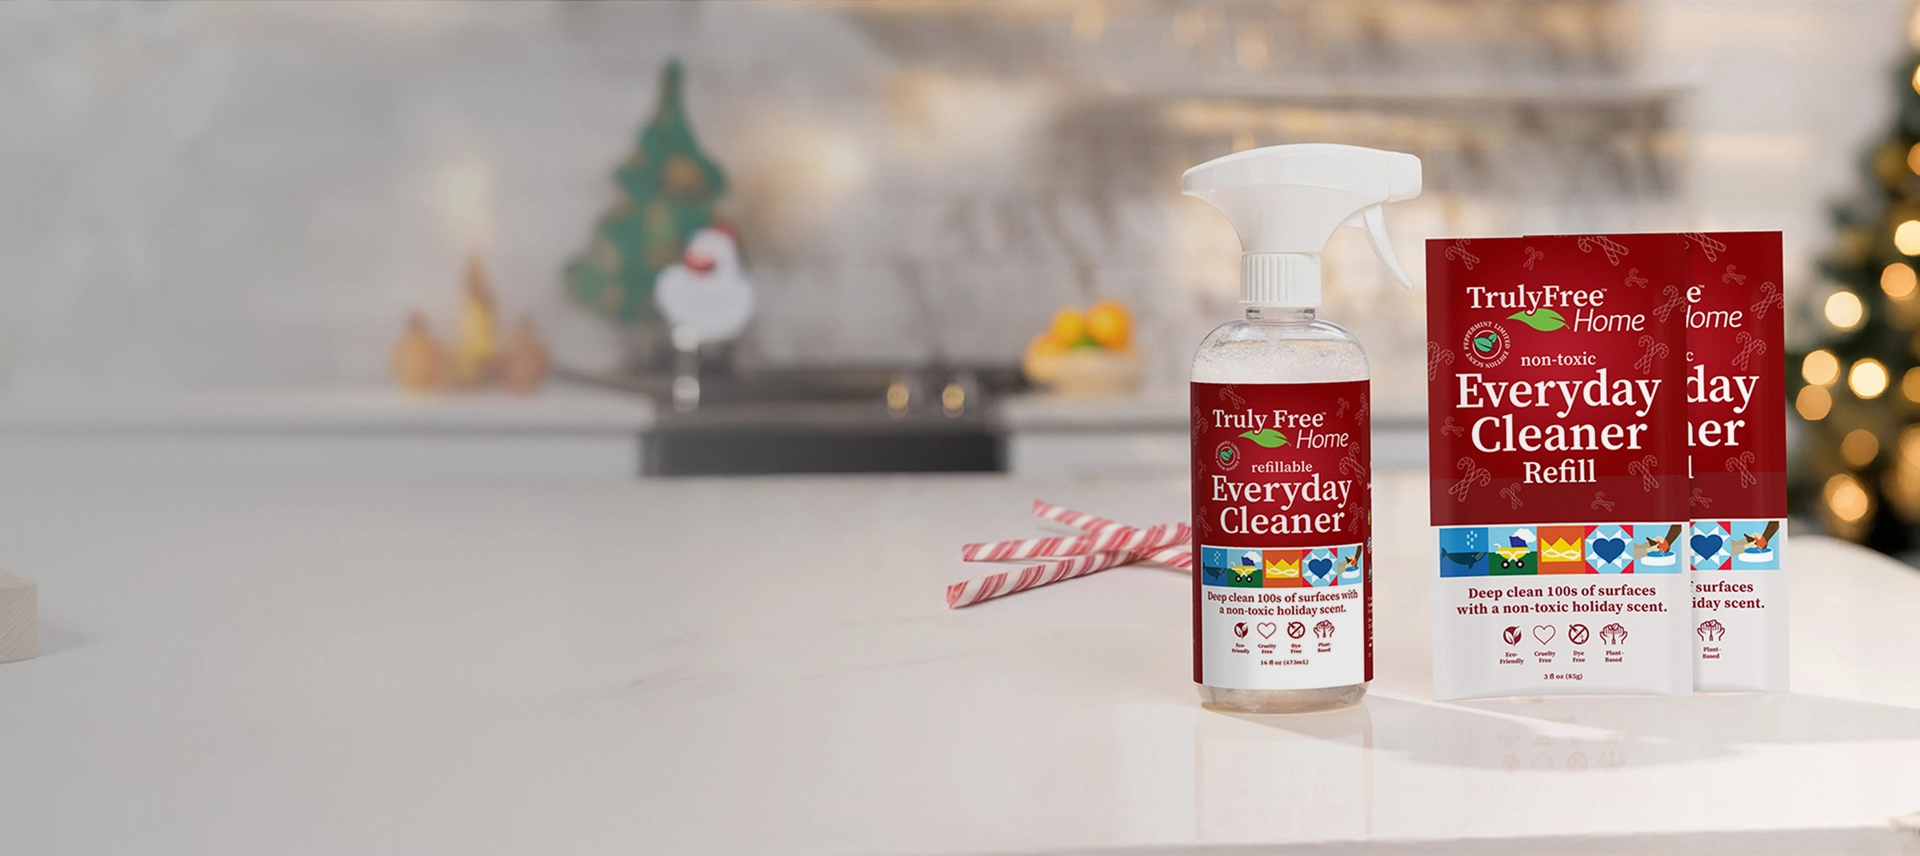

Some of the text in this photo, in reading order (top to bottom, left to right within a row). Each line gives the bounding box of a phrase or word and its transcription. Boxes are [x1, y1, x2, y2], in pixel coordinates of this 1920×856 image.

[1573, 308, 1645, 333] Home
[1463, 321, 1492, 350] PEPPERMINT
[1494, 323, 1511, 349] LIMITED
[1520, 352, 1597, 367] non-toxic
[1455, 367, 1662, 419] Everyday
[1212, 408, 1268, 434] Truly
[1296, 429, 1349, 449] Home
[1471, 413, 1648, 453] Cleaner
[1251, 461, 1313, 473] refillable
[1523, 458, 1597, 484] Refill
[1211, 472, 1352, 511] Everyday
[1219, 505, 1345, 534] Cleaner
[1468, 584, 1656, 601] Deep clean 100s of surfaces
[1695, 580, 1754, 593] surfaces
[1207, 589, 1358, 604] Deep clean 100s of surfaces with
[1692, 597, 1765, 611] iday scent.
[1226, 605, 1275, 616] non-toxic
[1276, 605, 1318, 617] holiday
[1319, 604, 1347, 614] scent.
[1457, 600, 1668, 615] with a non-toxic holiday scent.
[1533, 650, 1556, 658] Cruelty
[1565, 672, 1583, 681] (85g)
